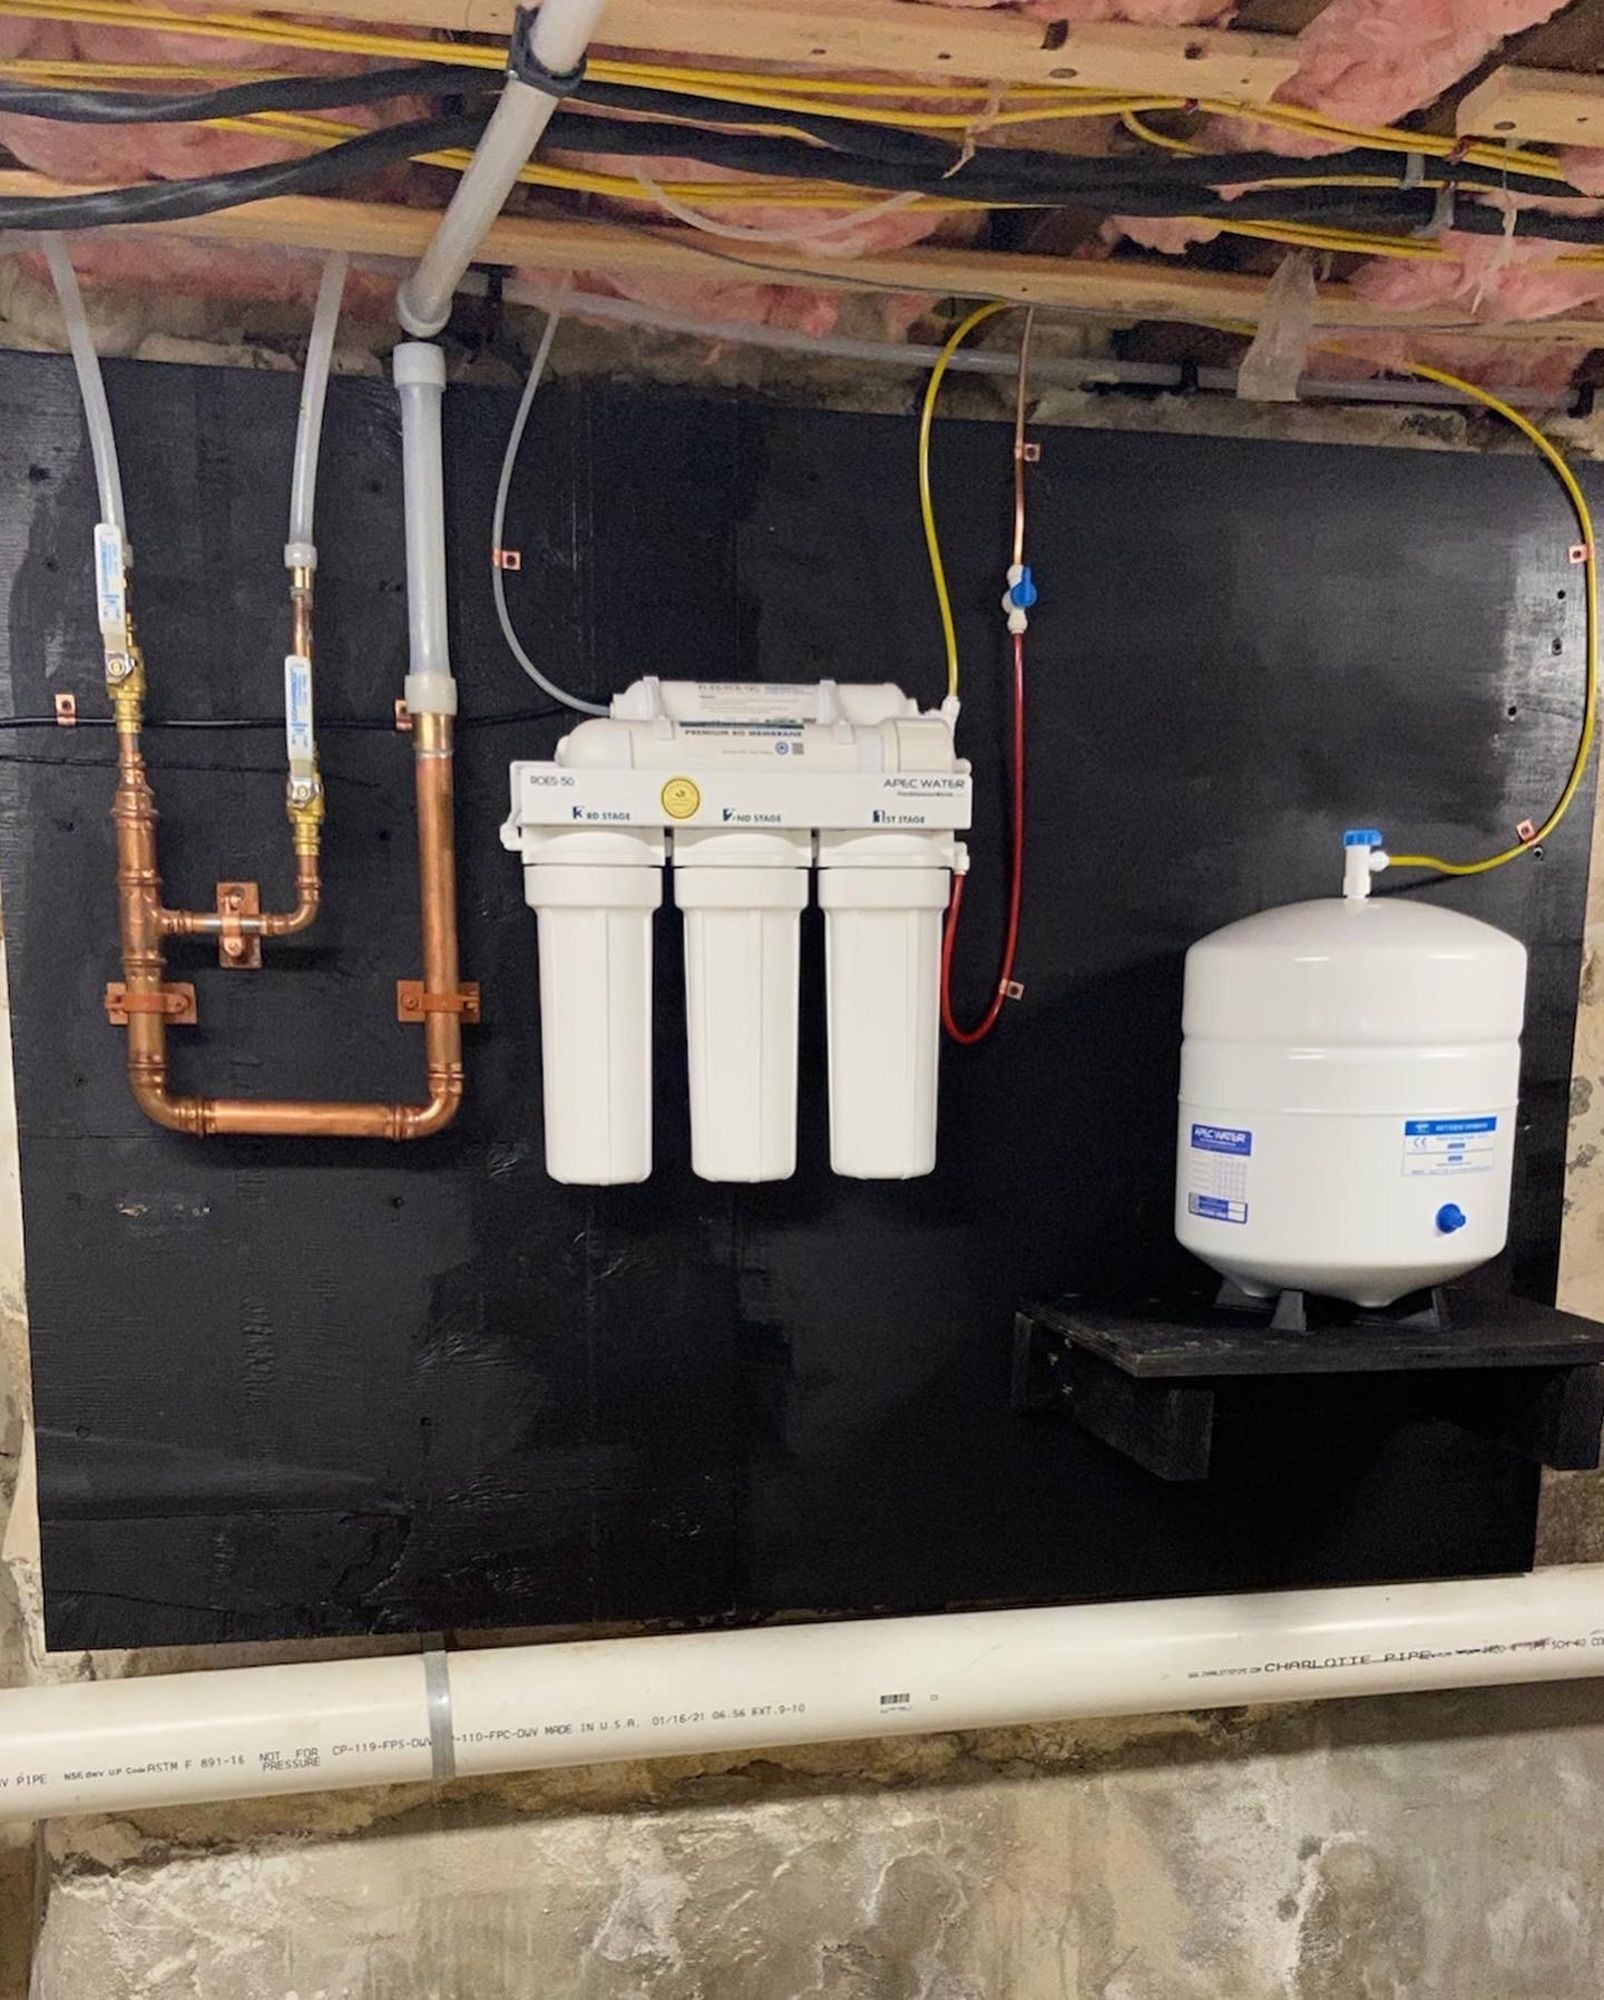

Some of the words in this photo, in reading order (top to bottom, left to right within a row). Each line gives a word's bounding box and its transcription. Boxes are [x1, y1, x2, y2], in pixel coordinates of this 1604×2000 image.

[883, 778, 917, 788] APEC
[920, 778, 965, 788] WATER
[602, 812, 630, 820] STAGE
[753, 814, 782, 822] STAGE
[898, 815, 925, 823] STAGE
[1264, 1655, 1372, 1672] CHARLOTTE
[1383, 1650, 1432, 1662] PIPE
[452, 1728, 538, 1743] -110-FPC-DWV
[544, 1723, 572, 1735] MADE
[581, 1721, 594, 1732] IN
[260, 1751, 280, 1762] NOT
[296, 1747, 318, 1758] FOR
[16, 1773, 47, 1786] PIPE
[147, 1761, 178, 1773] ASTM
[200, 1754, 245, 1769] 891-16
[263, 1757, 320, 1771] PRESSURE
